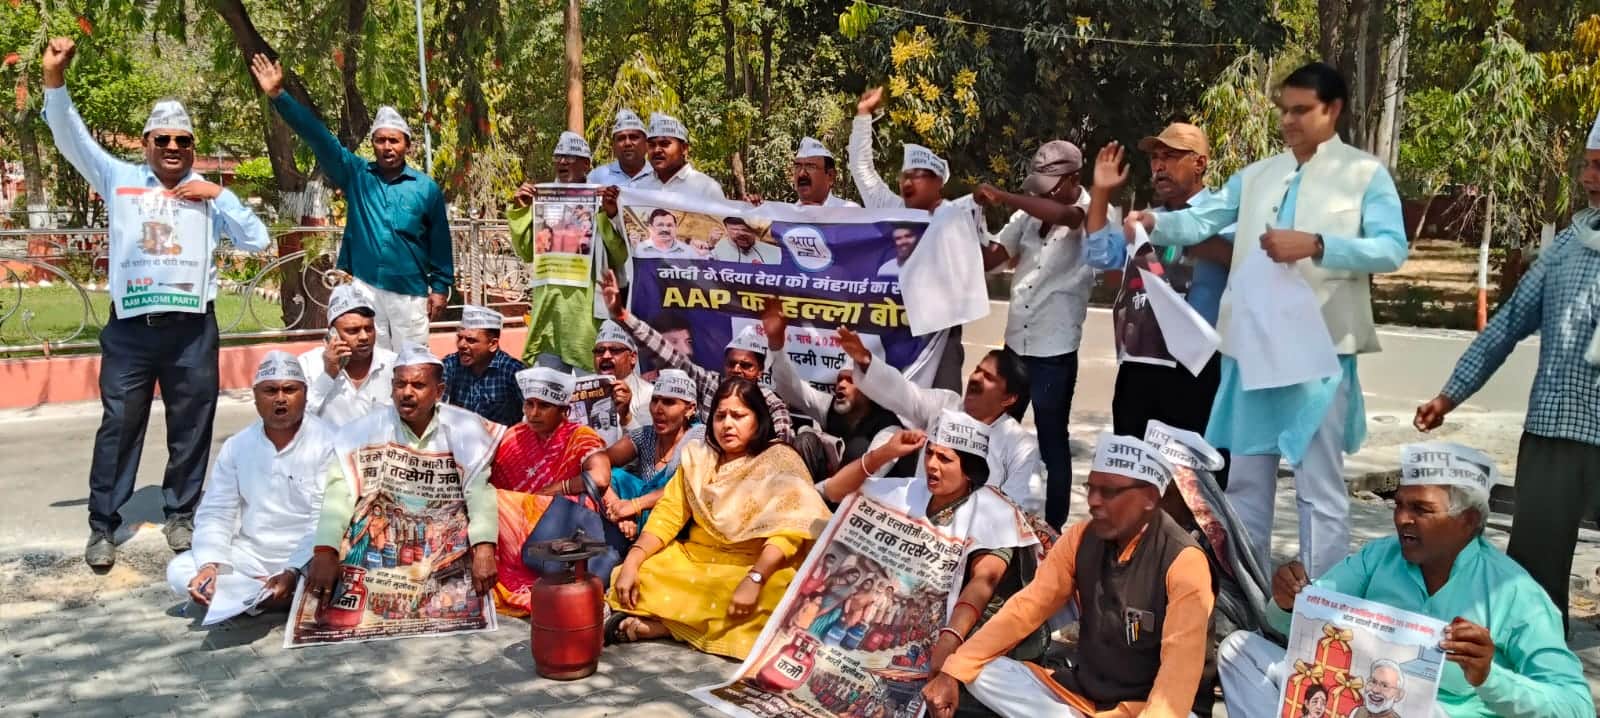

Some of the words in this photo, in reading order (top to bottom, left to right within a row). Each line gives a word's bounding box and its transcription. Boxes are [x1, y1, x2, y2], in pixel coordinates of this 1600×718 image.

[656, 264, 700, 281] मोदी
[719, 268, 753, 286] दिया
[755, 270, 782, 287] देश
[784, 272, 810, 289] को
[869, 281, 890, 295] का
[124, 297, 140, 306] AAM
[141, 295, 172, 304] AADMI
[173, 295, 198, 306] PARTY
[662, 286, 732, 310] AAP
[778, 295, 865, 325] हल्ला
[943, 434, 969, 447] आम
[947, 422, 976, 439] आप
[1107, 442, 1144, 463] आप
[1409, 450, 1452, 468] आप
[1104, 456, 1136, 471] आम
[1410, 467, 1445, 479] आम
[389, 463, 435, 486] तरसेगी
[857, 501, 877, 518] देश
[875, 510, 890, 524] में
[886, 516, 923, 539] एलपीजी
[848, 513, 876, 536] कब
[873, 527, 901, 547] तक
[898, 539, 941, 565] तरसेगी
[776, 658, 803, 680] कमी
